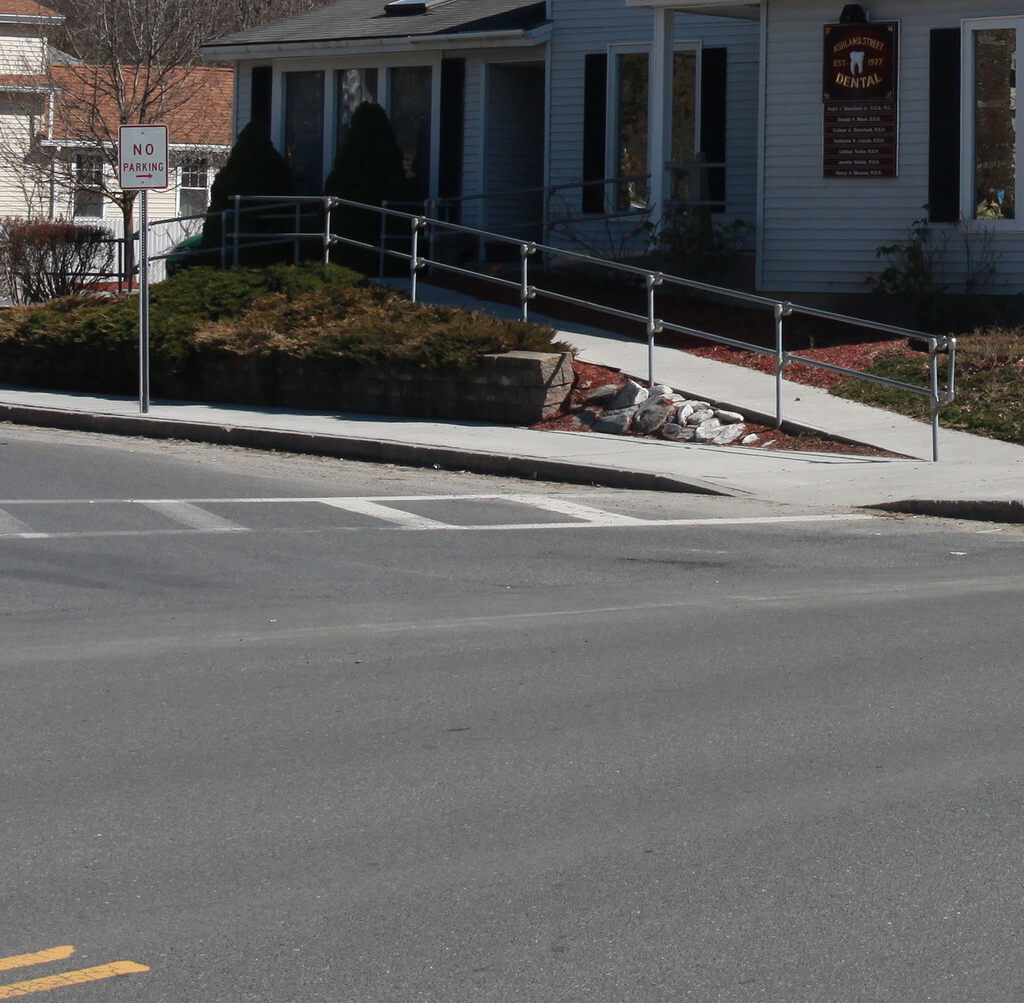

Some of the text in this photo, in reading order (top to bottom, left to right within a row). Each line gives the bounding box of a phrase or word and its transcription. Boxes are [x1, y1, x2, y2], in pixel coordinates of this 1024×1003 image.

[833, 37, 884, 53] ASHLAND STREET
[868, 58, 883, 66] 1977
[835, 72, 883, 88] DENTAL
[133, 143, 154, 156] NO
[123, 162, 164, 172] PARKING
